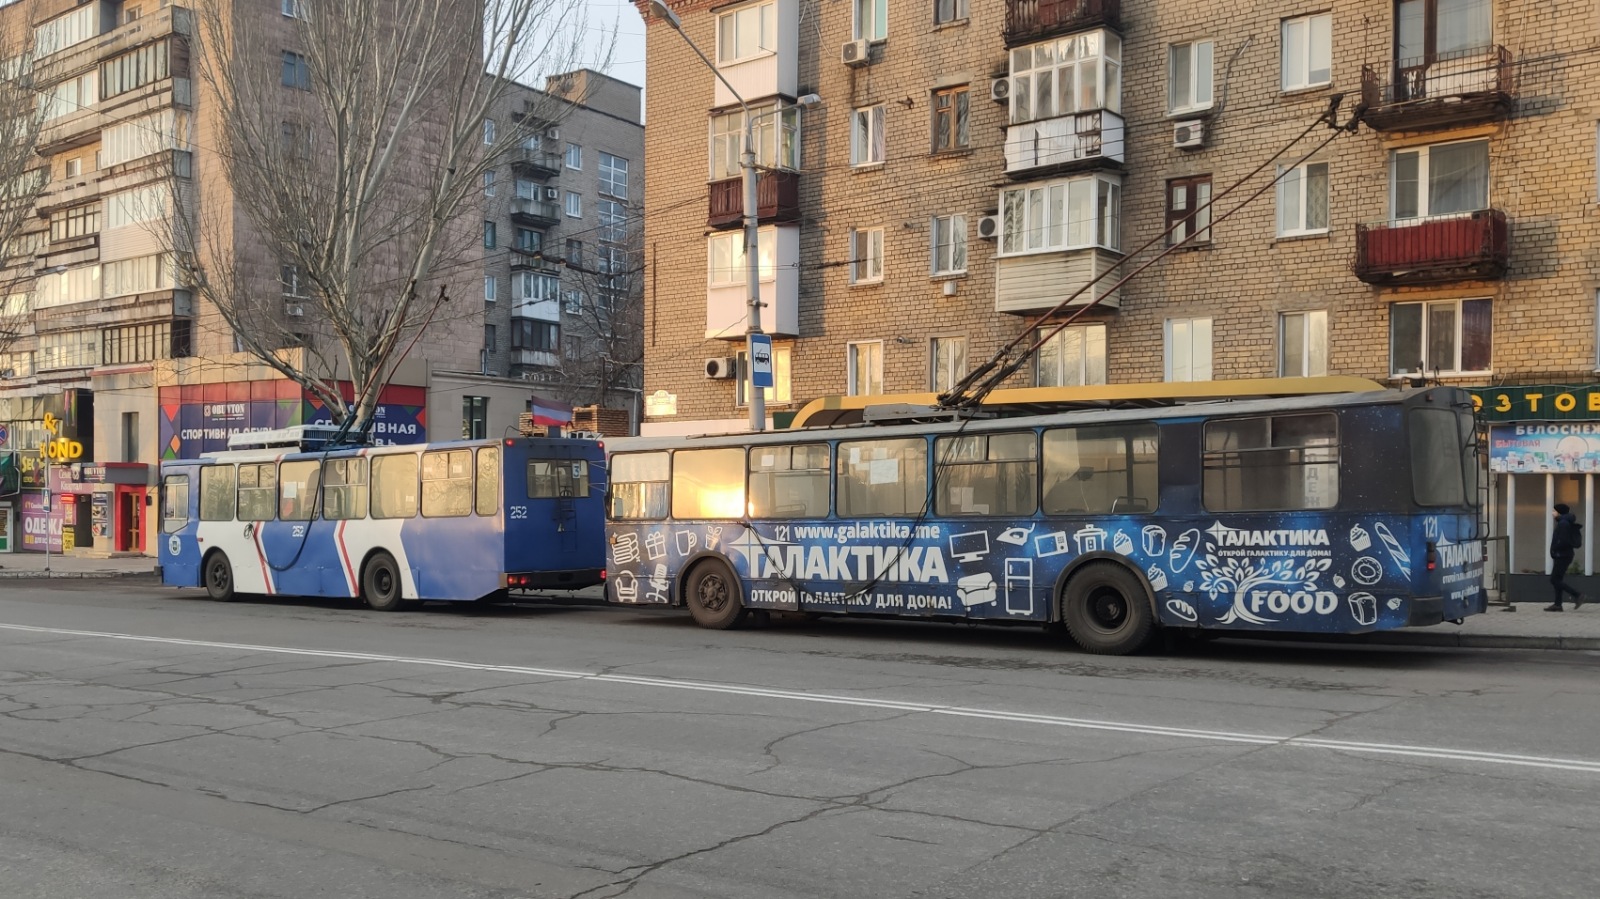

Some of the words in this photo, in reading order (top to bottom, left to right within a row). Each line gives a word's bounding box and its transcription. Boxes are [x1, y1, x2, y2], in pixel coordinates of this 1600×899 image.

[510, 506, 528, 519] 252
[292, 525, 304, 537] 252
[774, 525, 790, 541] 121
[794, 522, 941, 544] www.galaktika.me
[1423, 516, 1438, 538] 121
[1217, 529, 1330, 547] ГАЛАКТИКА
[1218, 549, 1246, 557] ОТКРОЙ
[1247, 549, 1288, 557] ГАЛАКТИКУ
[1290, 550, 1305, 558] ДЛЯ
[750, 545, 949, 583] ГАЛАКТИКА
[751, 587, 796, 603] ОТКРОЙ
[800, 591, 873, 608] ГАЛАКТИКУ
[875, 593, 904, 609] ДЛЯ
[907, 594, 952, 610] ДОМА!
[1251, 590, 1339, 615] FOOD
